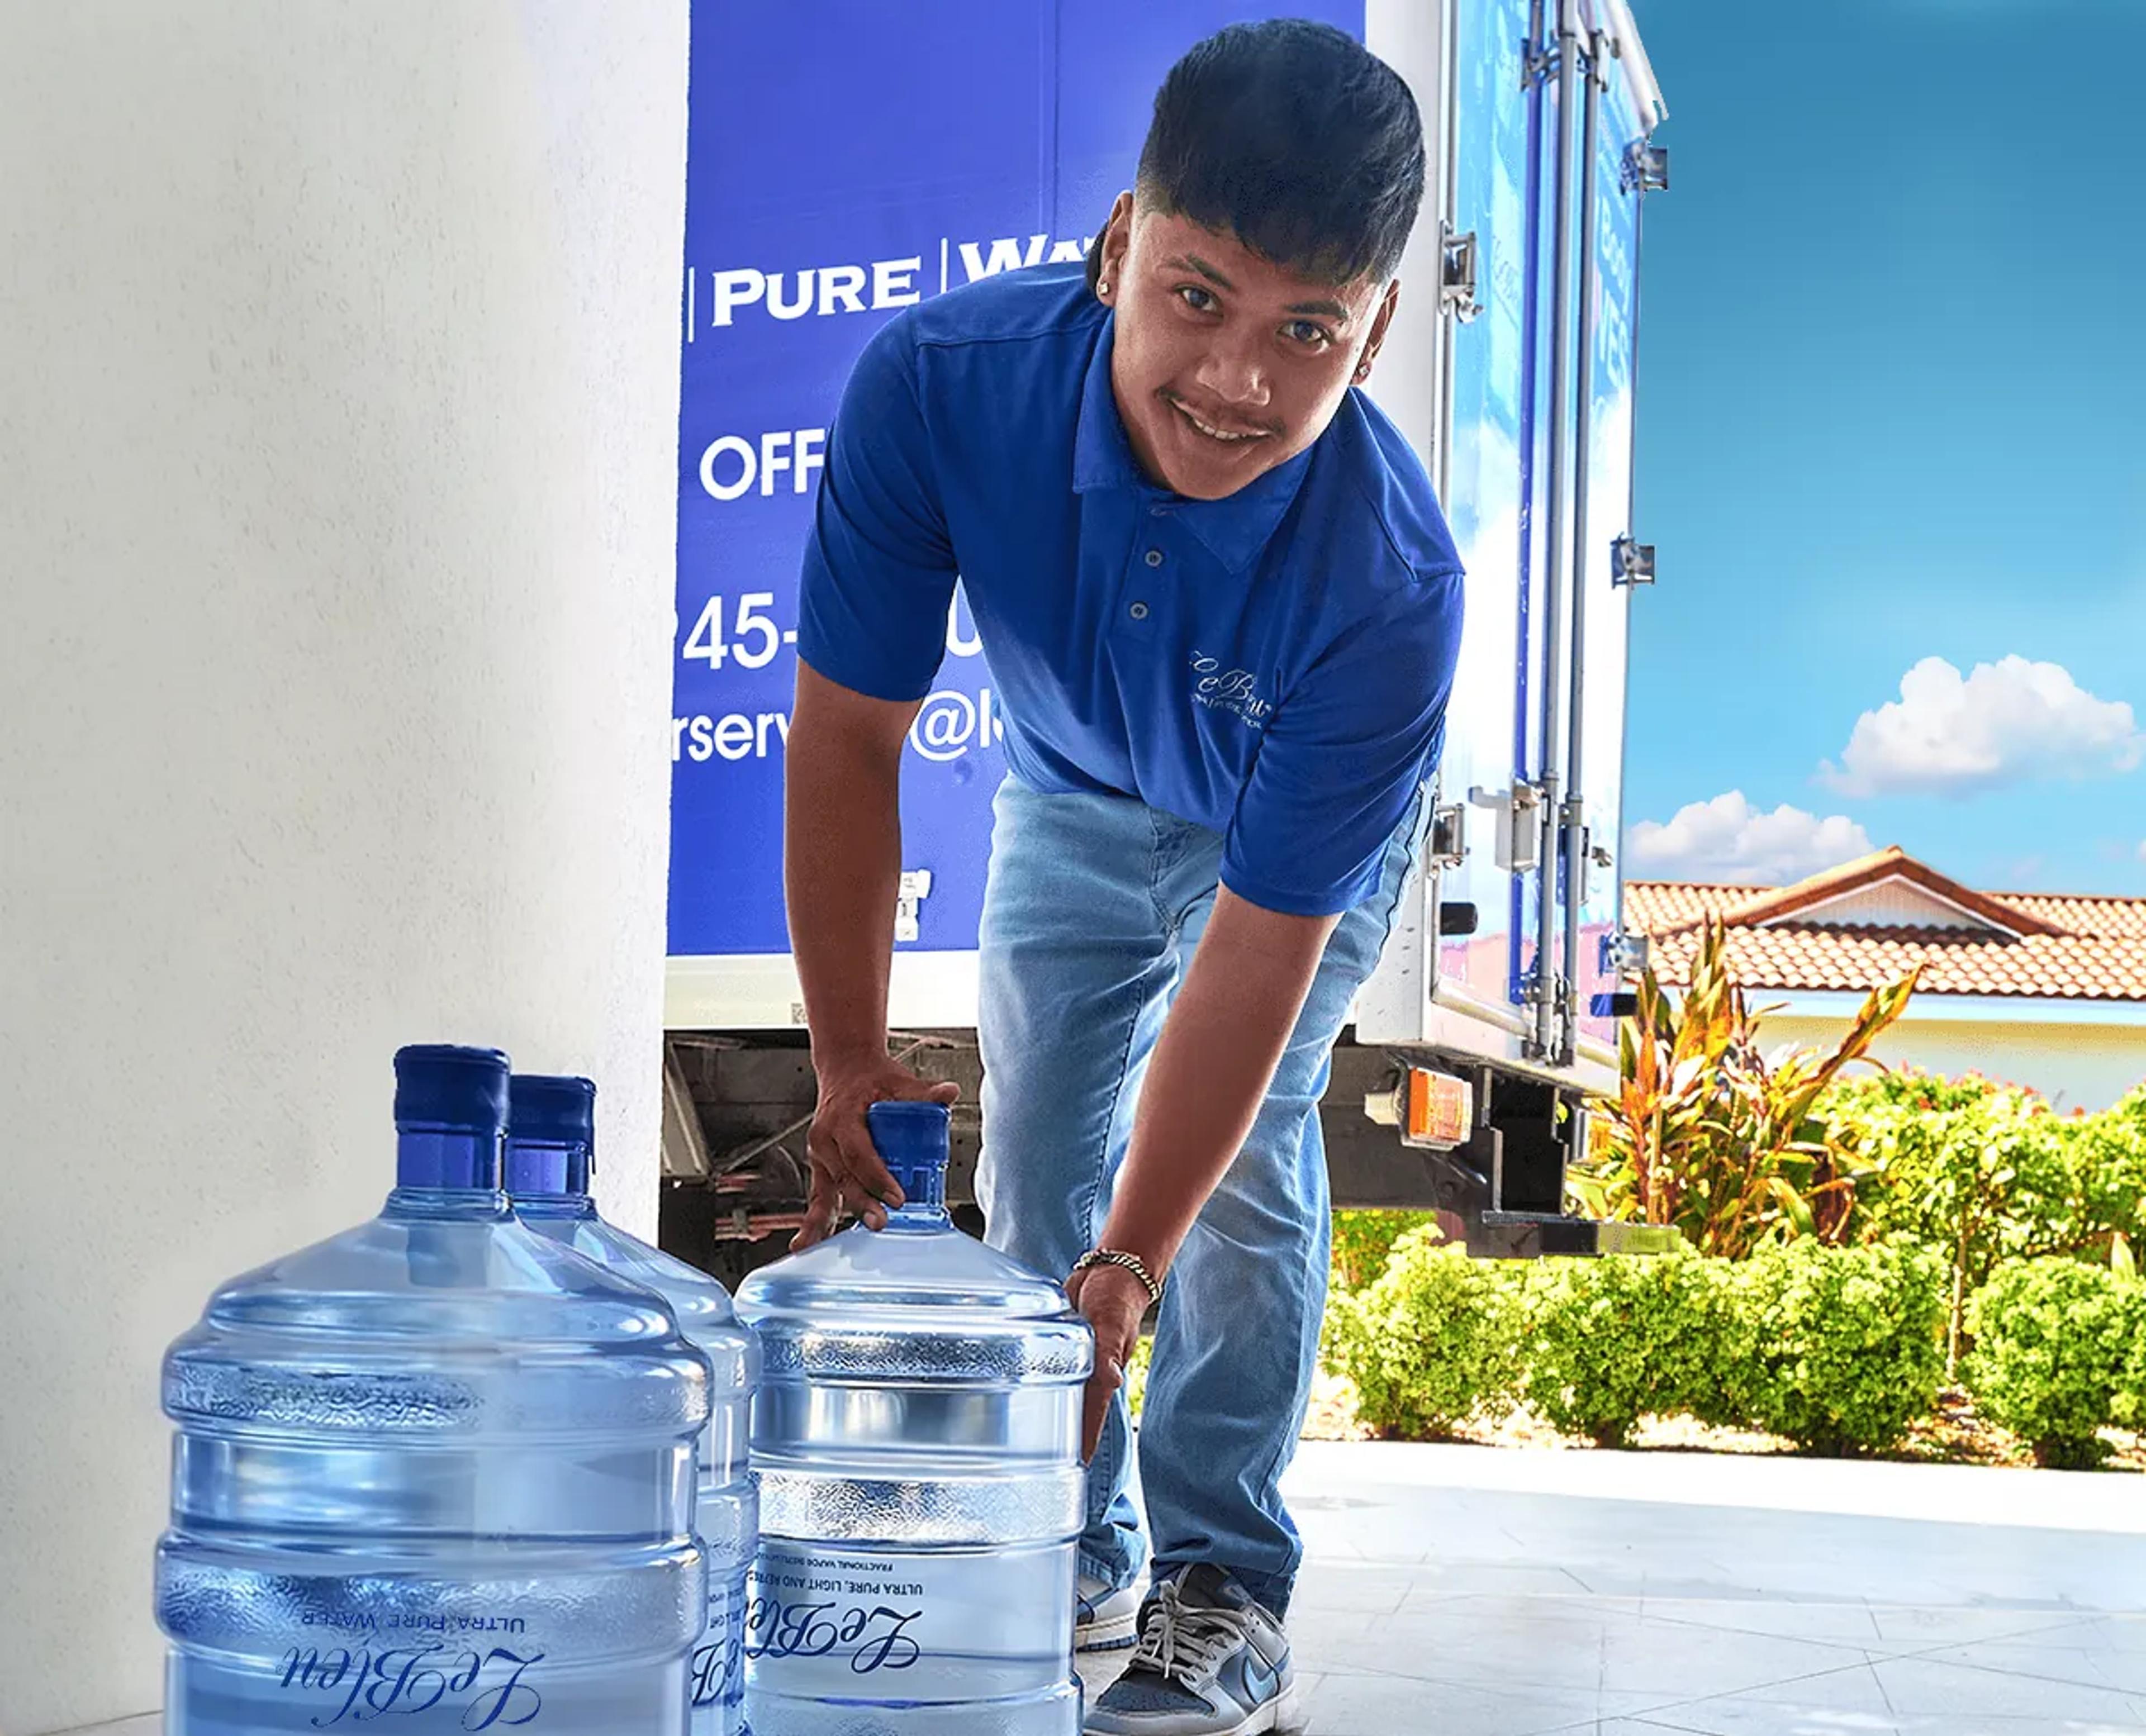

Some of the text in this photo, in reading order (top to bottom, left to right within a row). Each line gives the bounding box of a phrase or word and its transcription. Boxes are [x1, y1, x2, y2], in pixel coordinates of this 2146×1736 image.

[711, 256, 921, 326] PURE
[672, 592, 797, 669] 45-
[783, 1576, 806, 1589] AND
[808, 1578, 841, 1592] LIGHT
[844, 1581, 880, 1594] PURE,
[883, 1583, 923, 1595] ULTRA
[301, 1611, 525, 1634] ULTRA PURE WATER
